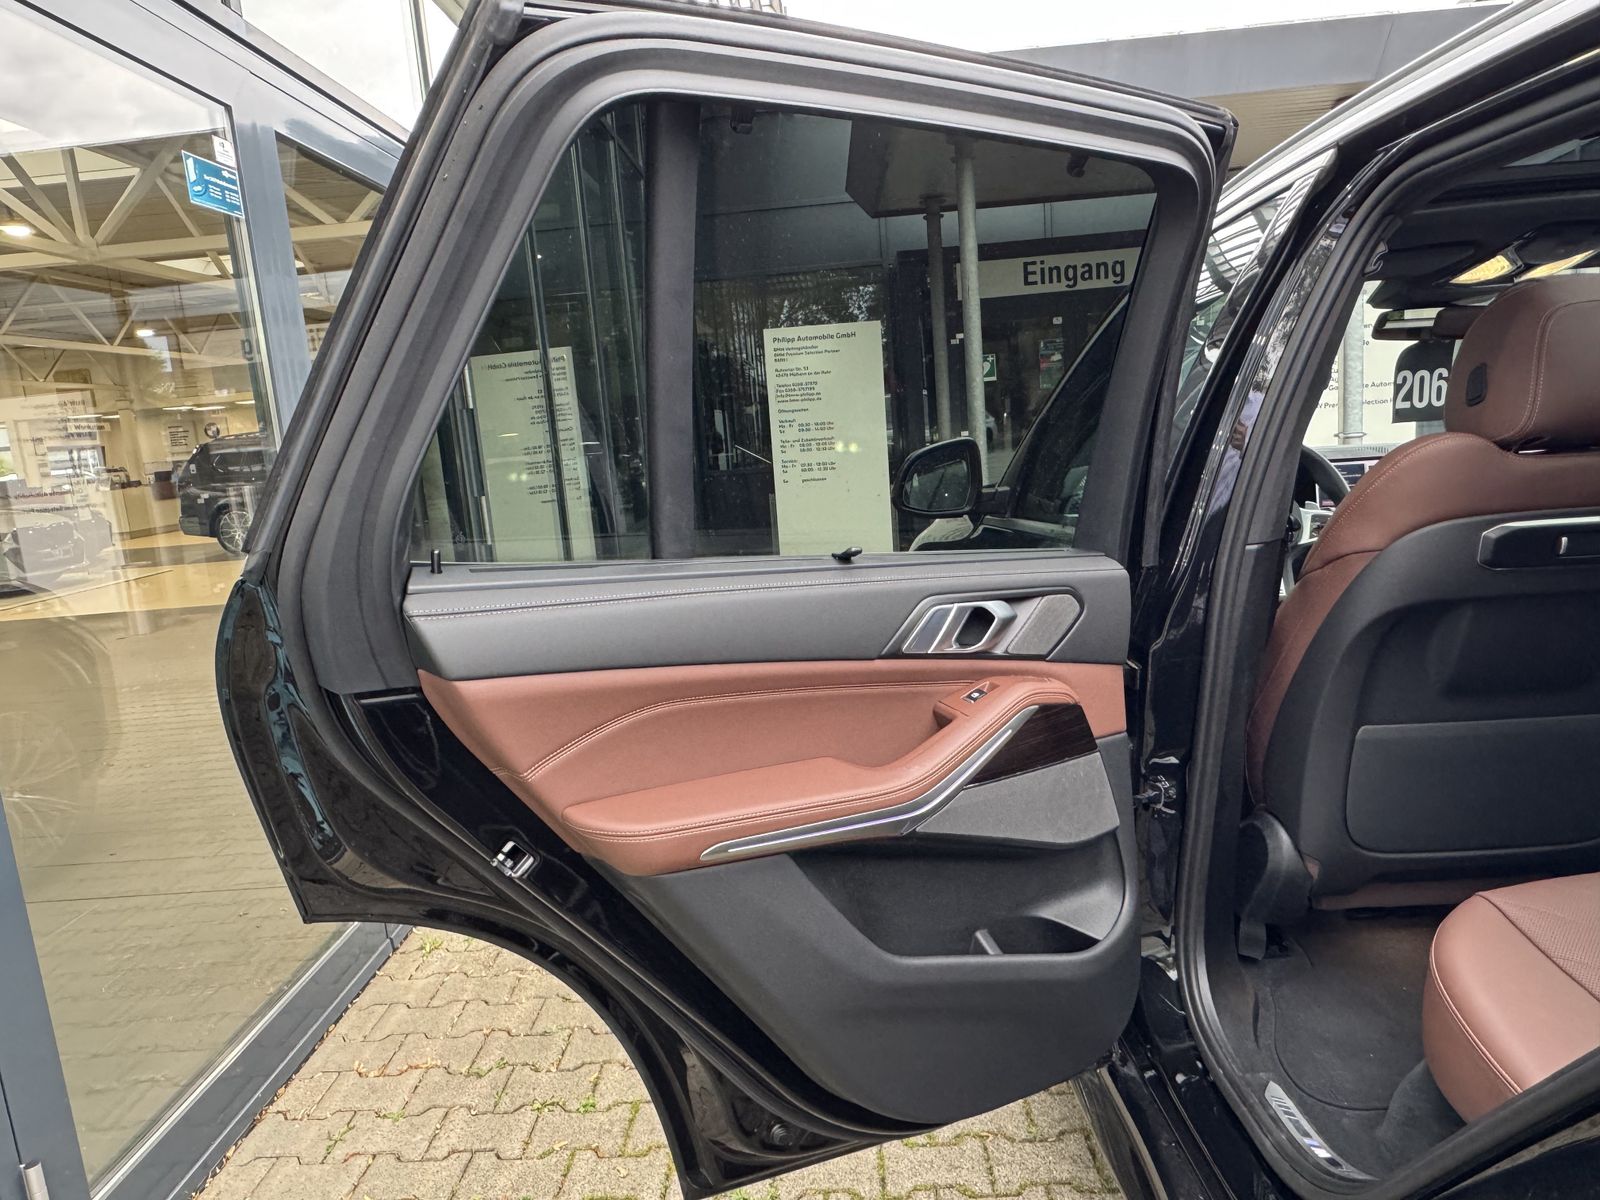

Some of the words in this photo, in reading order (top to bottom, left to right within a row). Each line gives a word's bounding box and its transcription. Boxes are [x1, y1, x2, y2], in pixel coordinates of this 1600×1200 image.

[1023, 260, 1125, 288] Eingang
[772, 336, 796, 344] Philipp
[796, 333, 834, 342] Automobile
[835, 331, 856, 339] GmbH
[1395, 367, 1449, 409] 206
